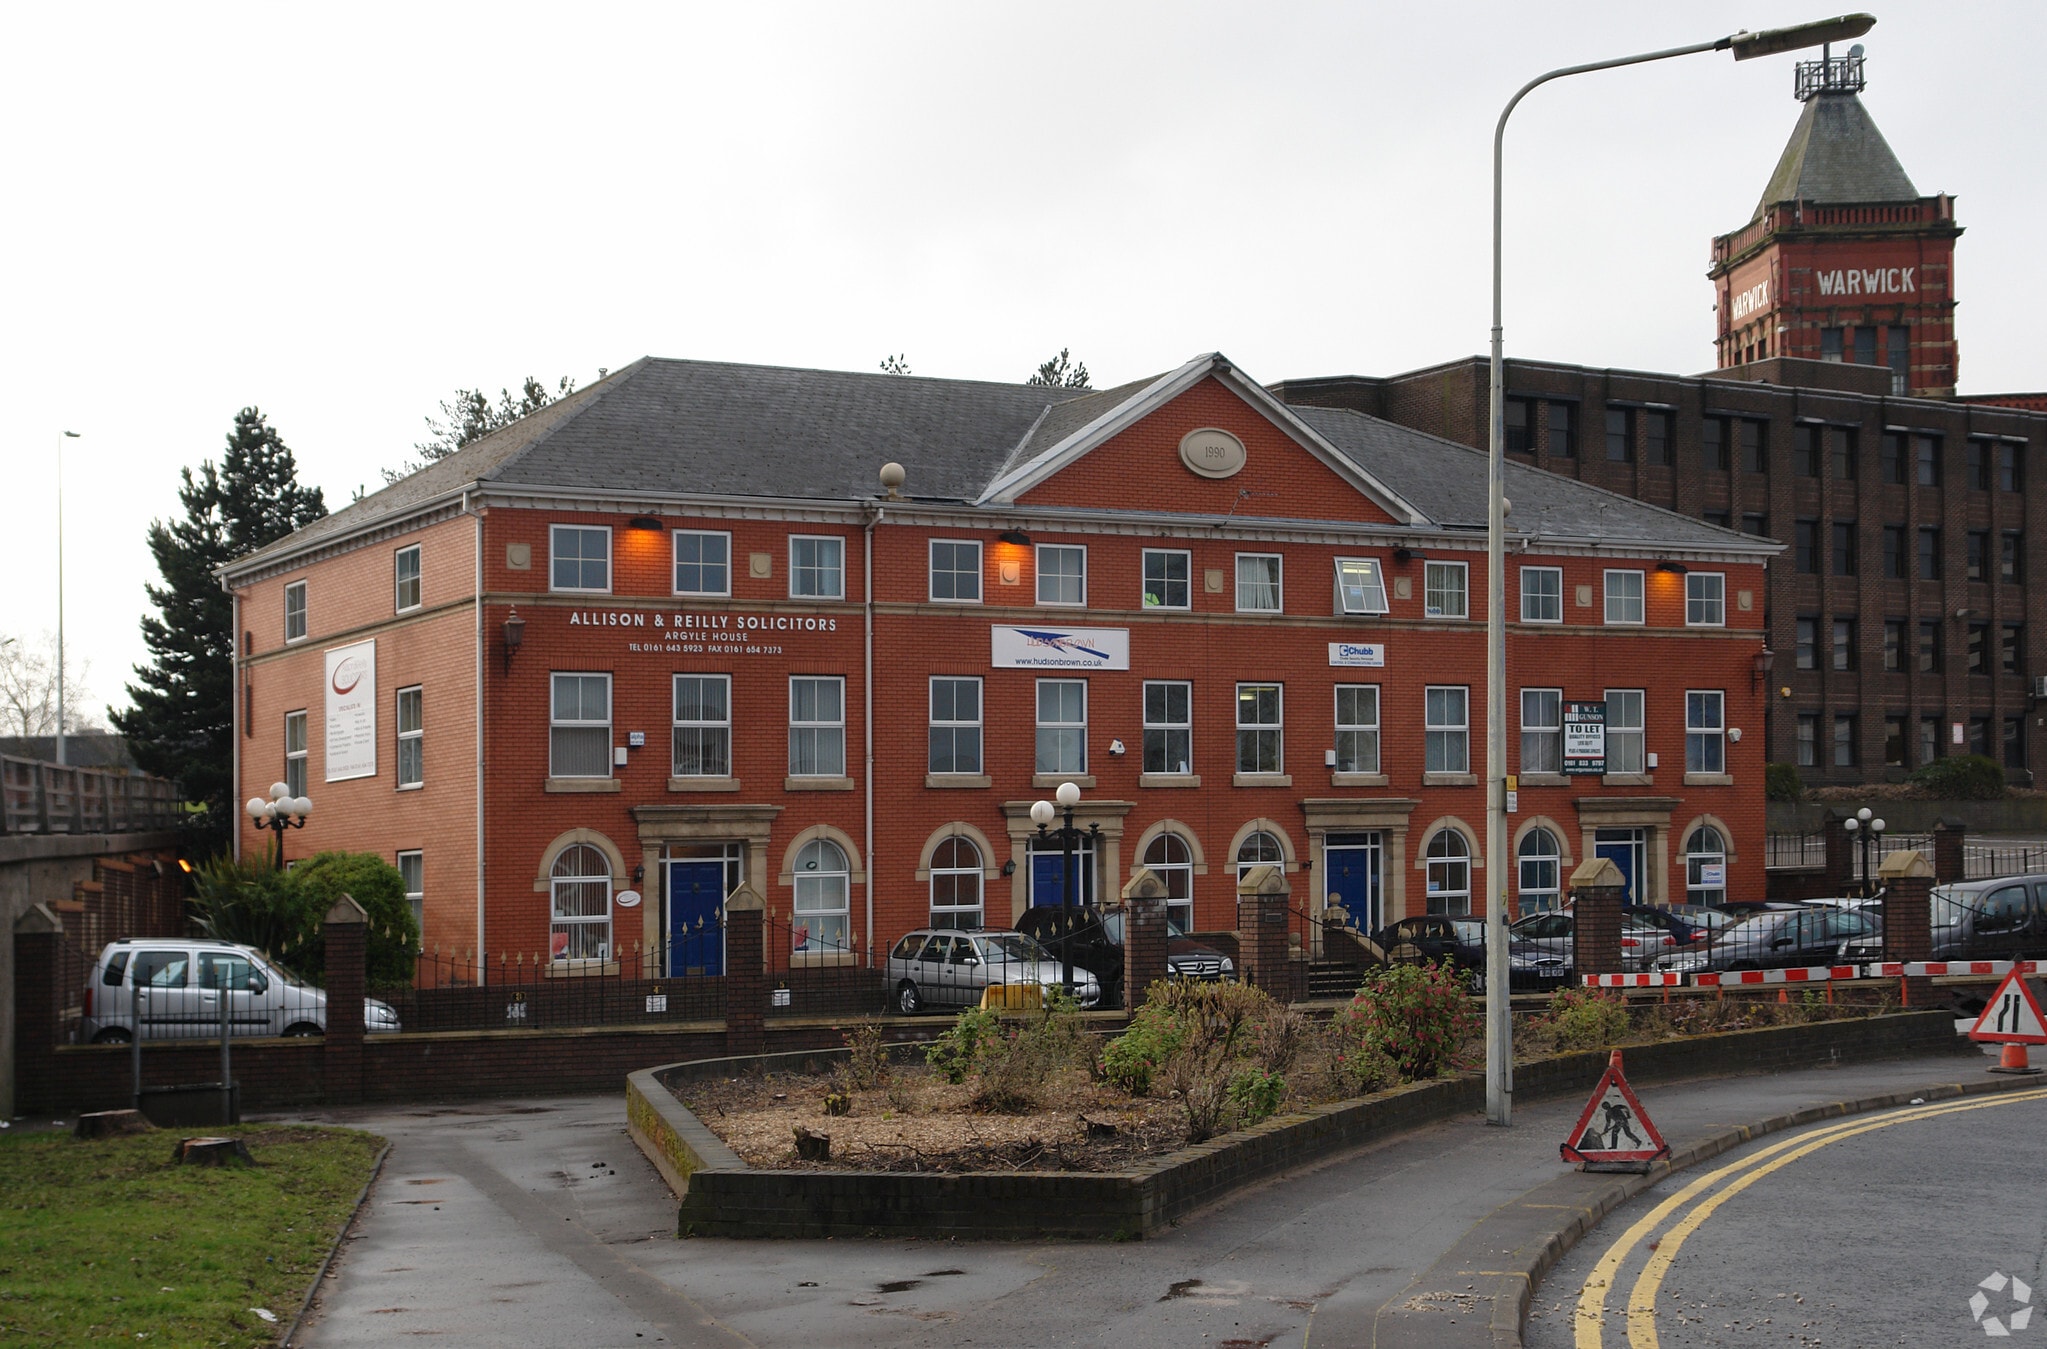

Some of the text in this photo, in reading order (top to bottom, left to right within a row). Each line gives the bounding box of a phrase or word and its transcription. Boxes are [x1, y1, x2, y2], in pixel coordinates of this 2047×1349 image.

[1817, 267, 1915, 296] WARWICK
[1732, 280, 1768, 321] WARWICK
[1205, 446, 1225, 458] 1990
[570, 612, 836, 631] ALLISON & REILLY SOLICITORS
[665, 632, 748, 641] ARGYLE HOUSE
[629, 643, 641, 651] TEL
[666, 644, 680, 652] 643
[683, 644, 703, 652] 5923
[708, 645, 721, 653] FAX
[724, 645, 743, 653] 0161
[763, 646, 782, 654] 7373
[1349, 647, 1373, 655] Chubb
[1015, 657, 1103, 667] www.hudsonbrown.co.uk
[1569, 725, 1601, 733] TO LET
